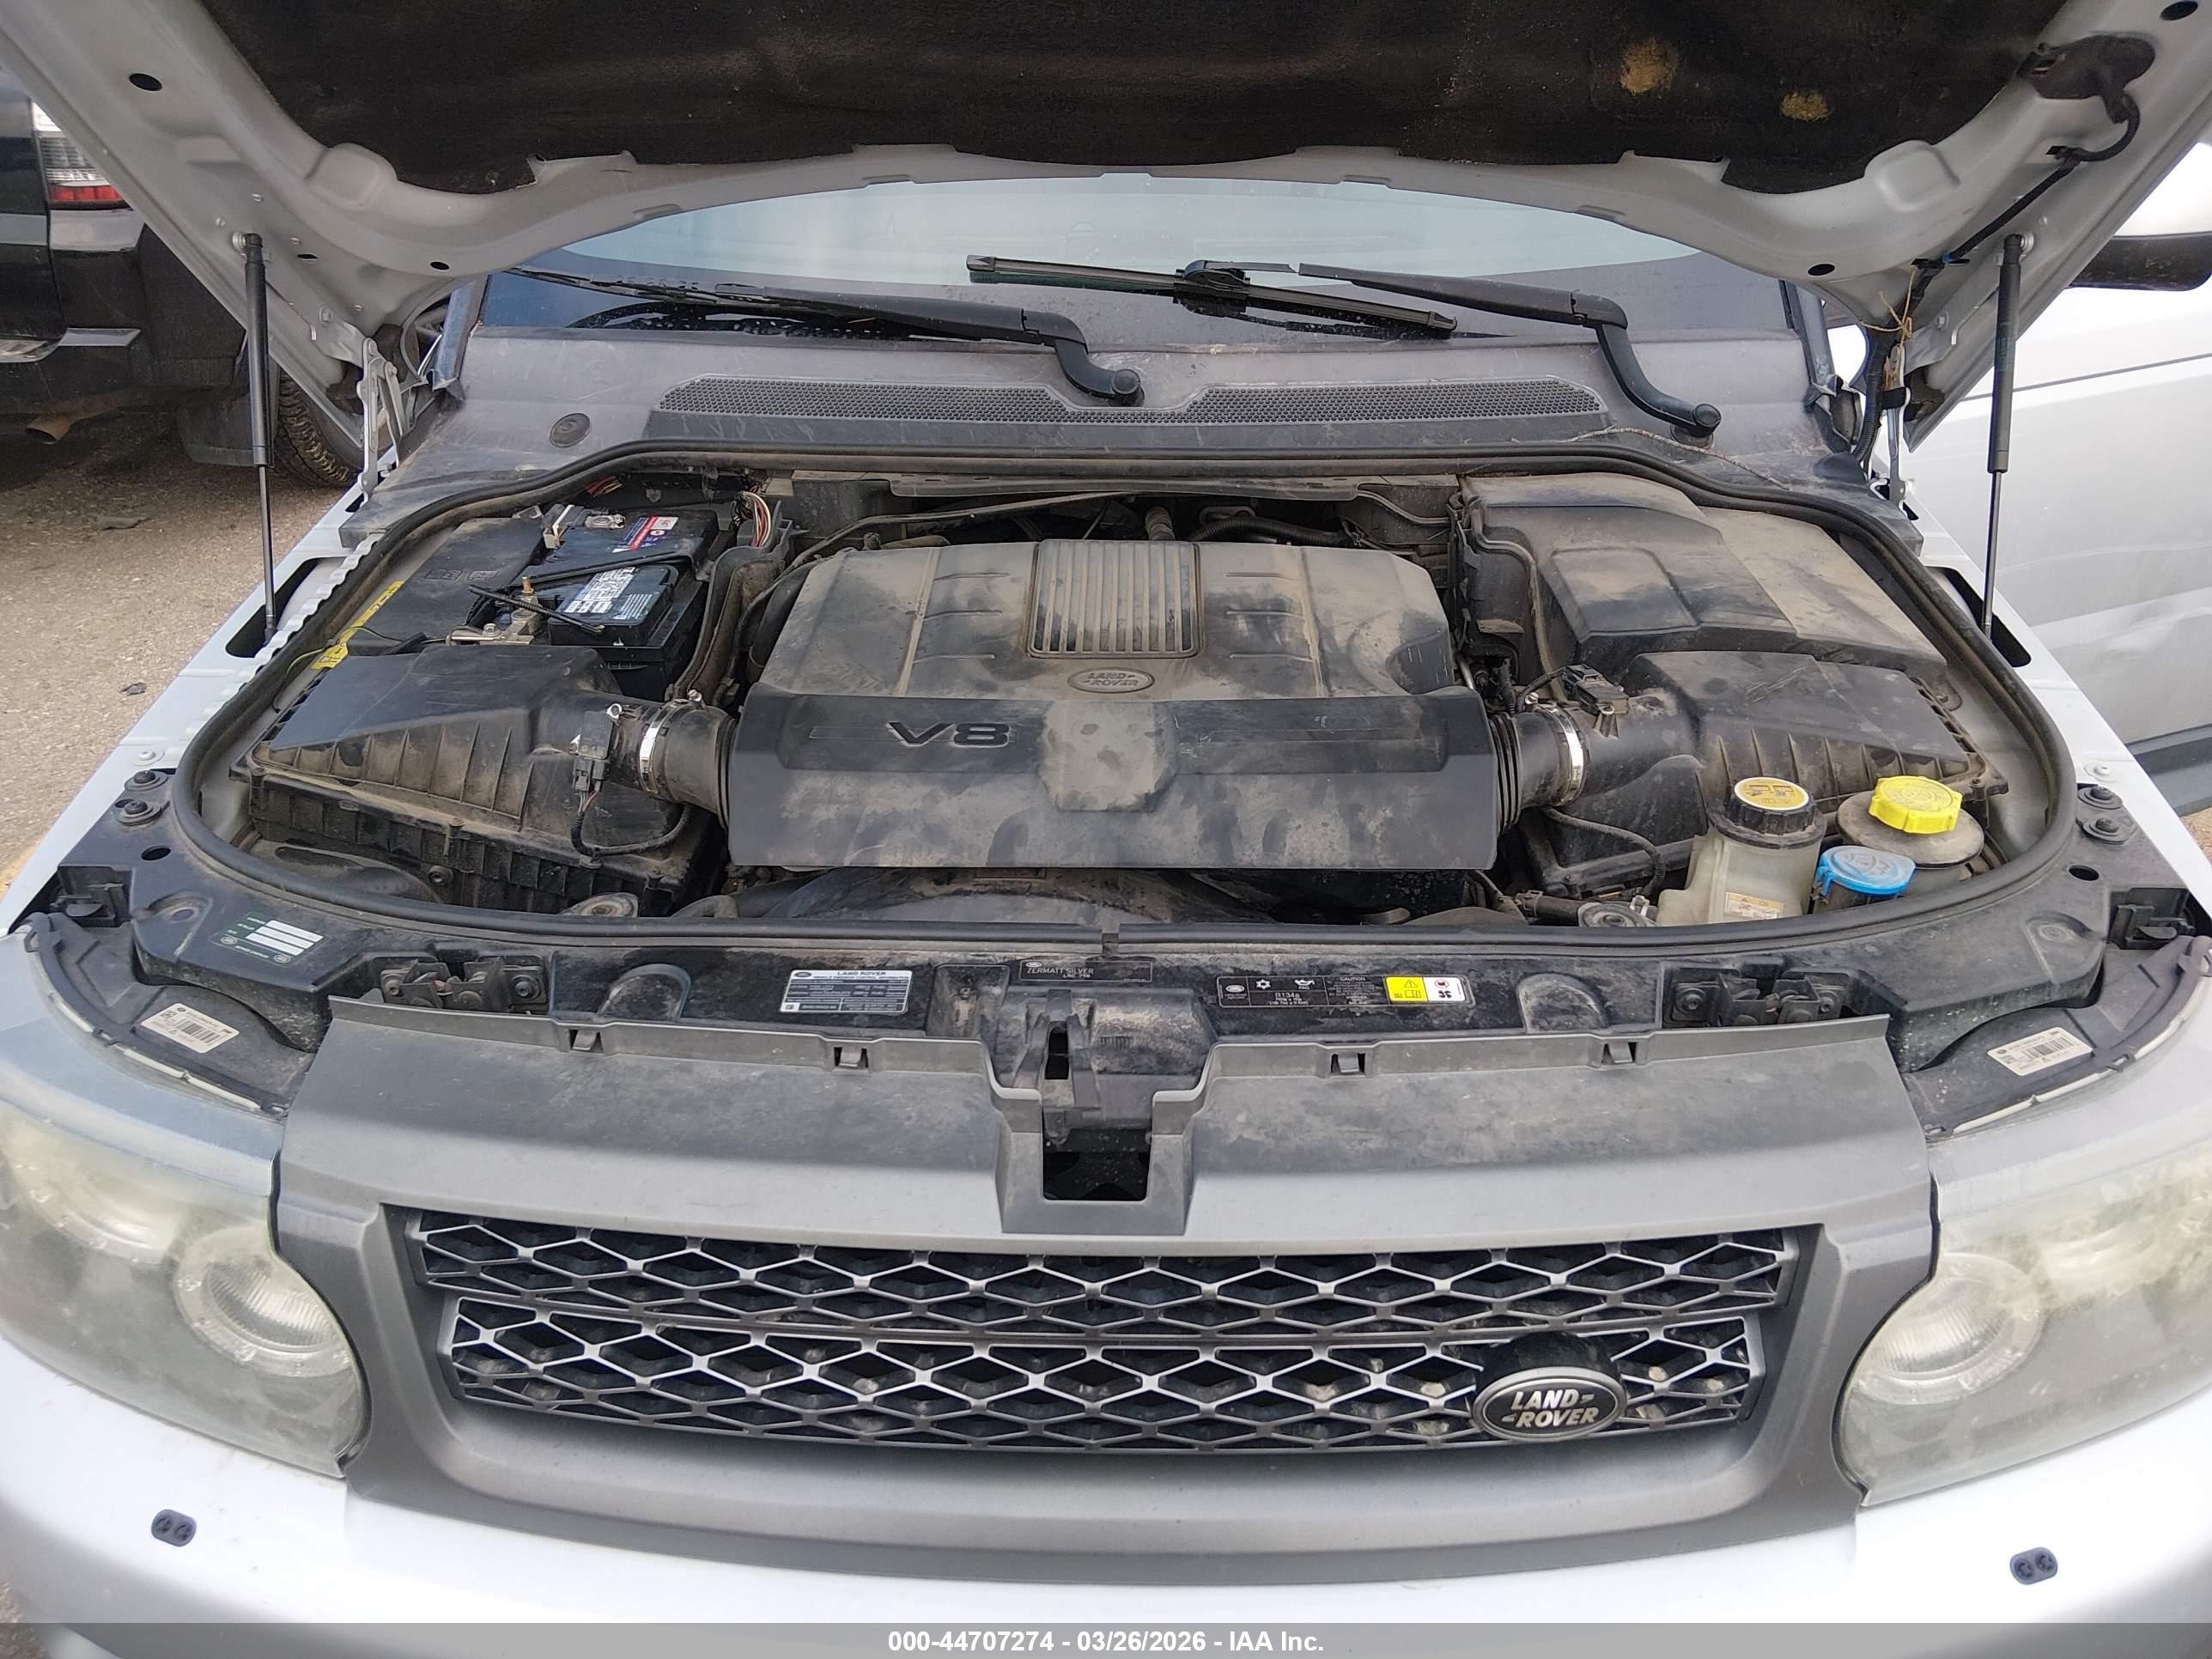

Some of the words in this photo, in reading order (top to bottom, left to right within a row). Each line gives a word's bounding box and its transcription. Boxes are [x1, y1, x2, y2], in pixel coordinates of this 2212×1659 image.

[1088, 672, 1127, 681] LAND
[1091, 679, 1139, 688] ROVER
[885, 720, 1012, 748] V8
[1065, 967, 1095, 975] SILVER
[1510, 1389, 1580, 1411] LAND
[1515, 1407, 1600, 1429] ROVER
